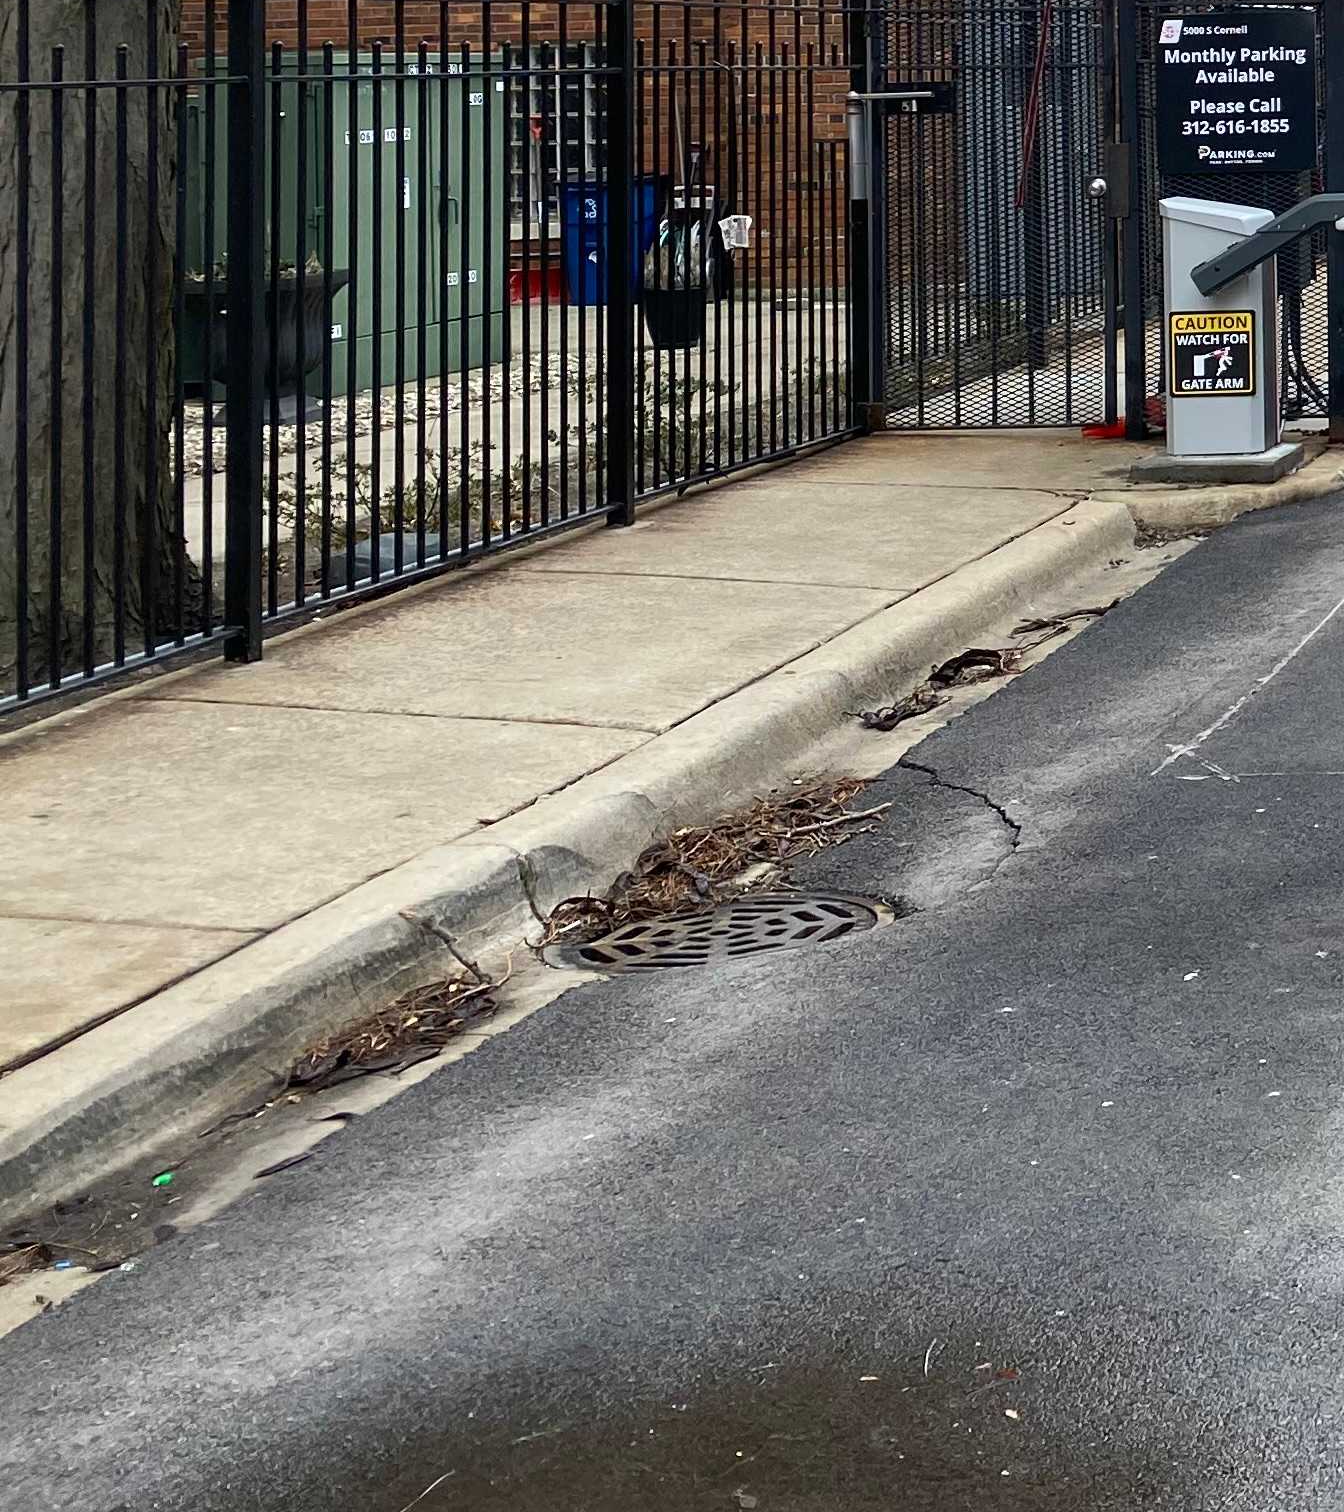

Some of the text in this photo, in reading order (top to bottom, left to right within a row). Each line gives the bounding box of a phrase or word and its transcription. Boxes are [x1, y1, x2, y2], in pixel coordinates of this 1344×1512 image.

[1183, 25, 1248, 36] 5000 S Cornell
[1164, 47, 1306, 66] Monthly Parking
[1195, 68, 1275, 84] Available
[1190, 98, 1281, 114] Please Call
[1182, 119, 1290, 135] 312-616-1855
[1175, 316, 1247, 330] CAUTION
[1176, 333, 1248, 346] WATCH FOR
[1182, 378, 1244, 390] GATE ARM
